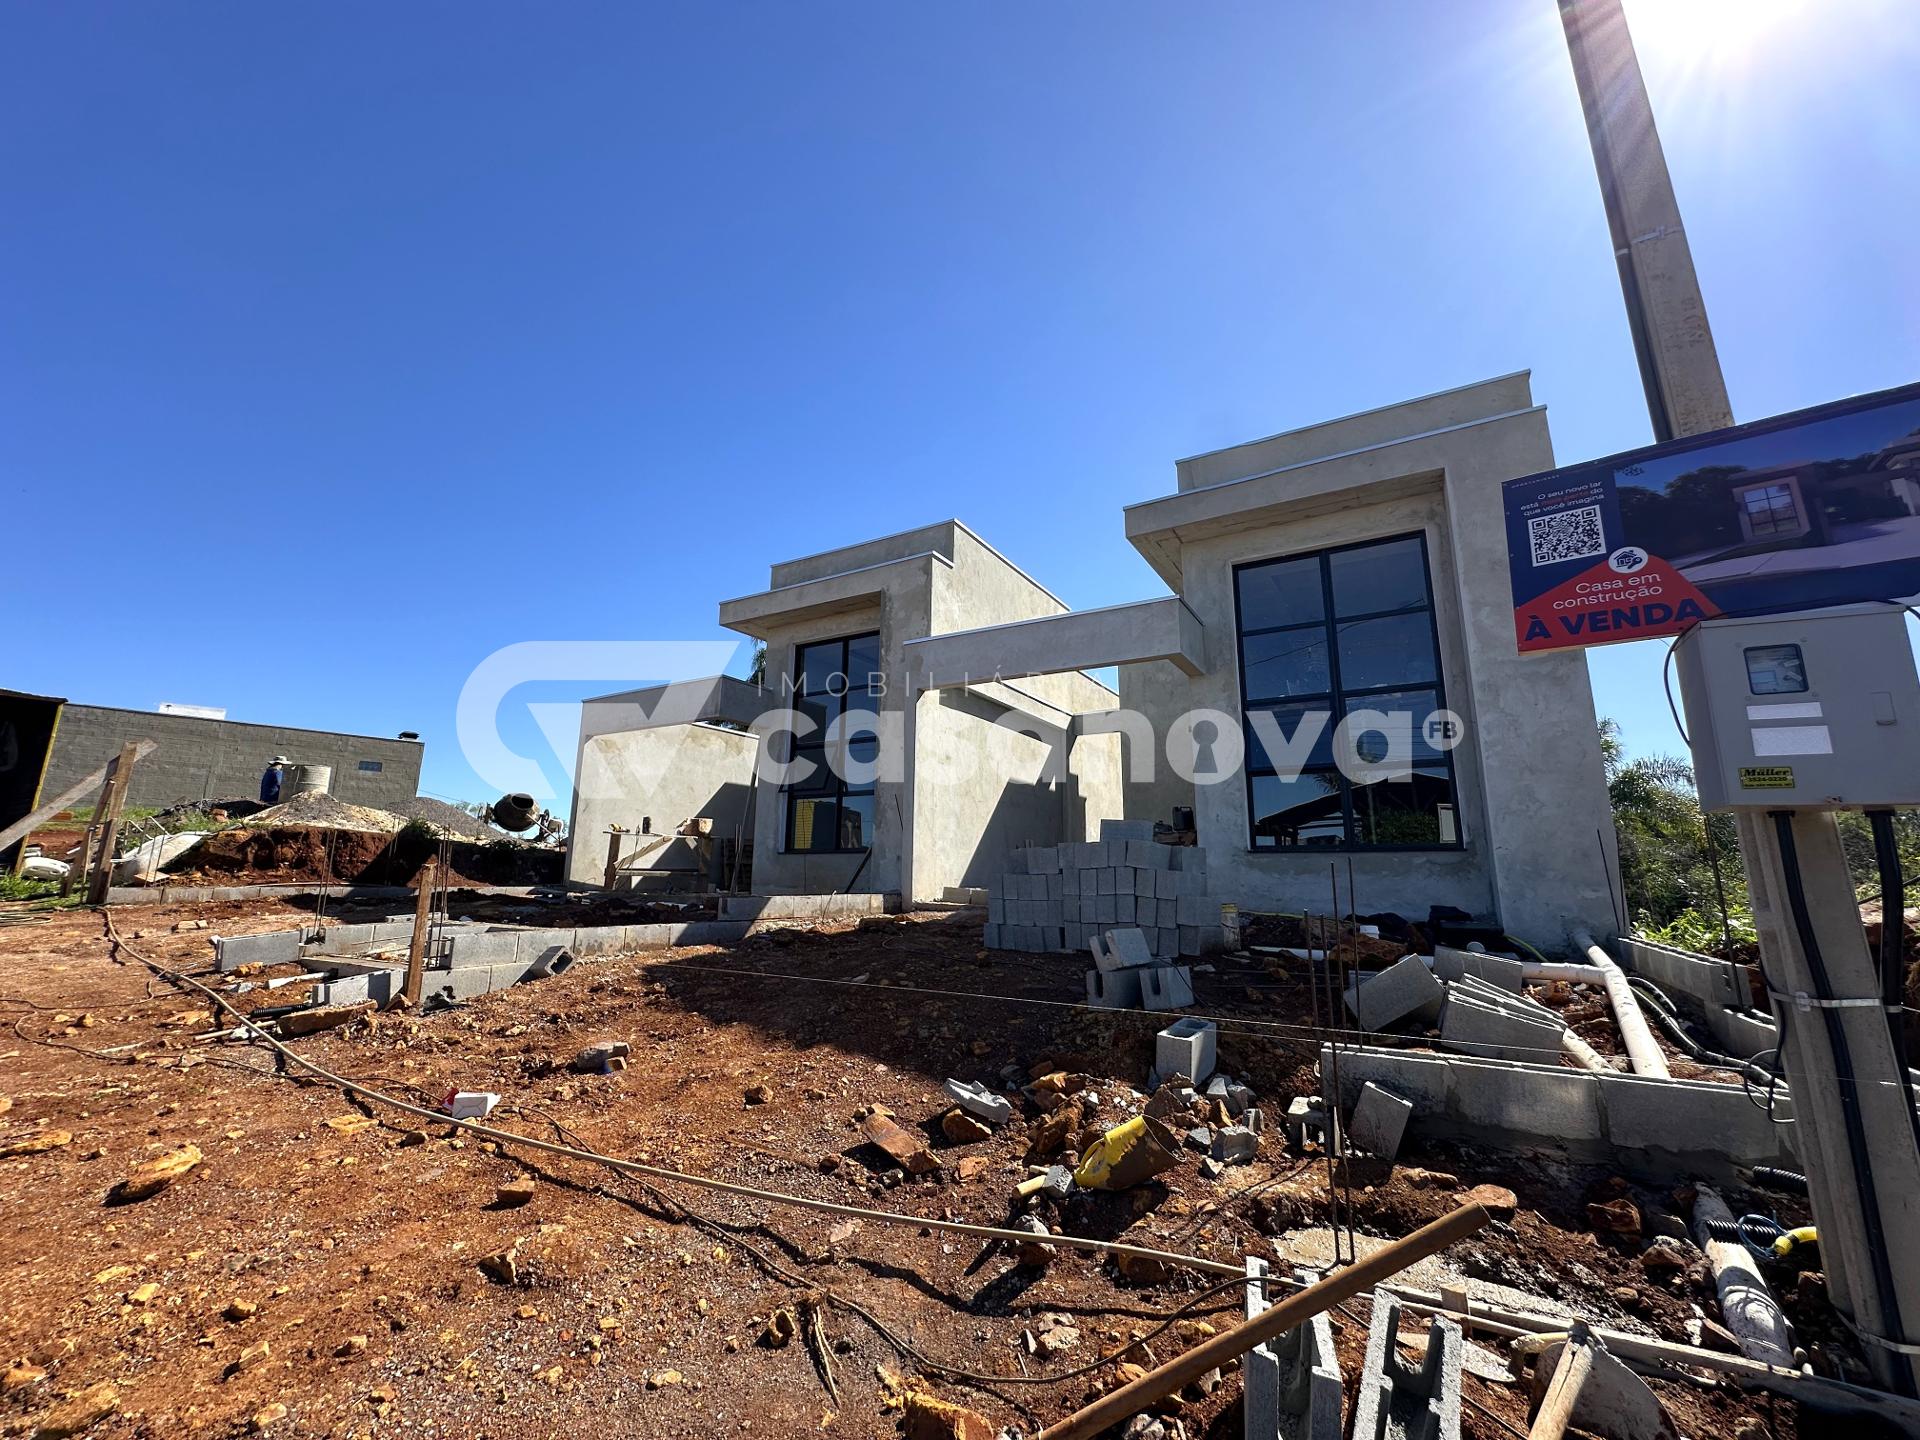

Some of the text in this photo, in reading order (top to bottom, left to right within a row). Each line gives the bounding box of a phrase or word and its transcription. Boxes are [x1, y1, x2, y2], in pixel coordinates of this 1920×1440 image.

[1547, 490, 1564, 498] seu
[1565, 485, 1589, 494] novo
[1520, 502, 1539, 511] está
[1523, 509, 1541, 517] que
[1542, 502, 1566, 512] você
[1567, 494, 1605, 506] imagina
[1575, 572, 1662, 595] Casa em
[1552, 585, 1663, 610] construção
[1524, 598, 1707, 642] À VENDA
